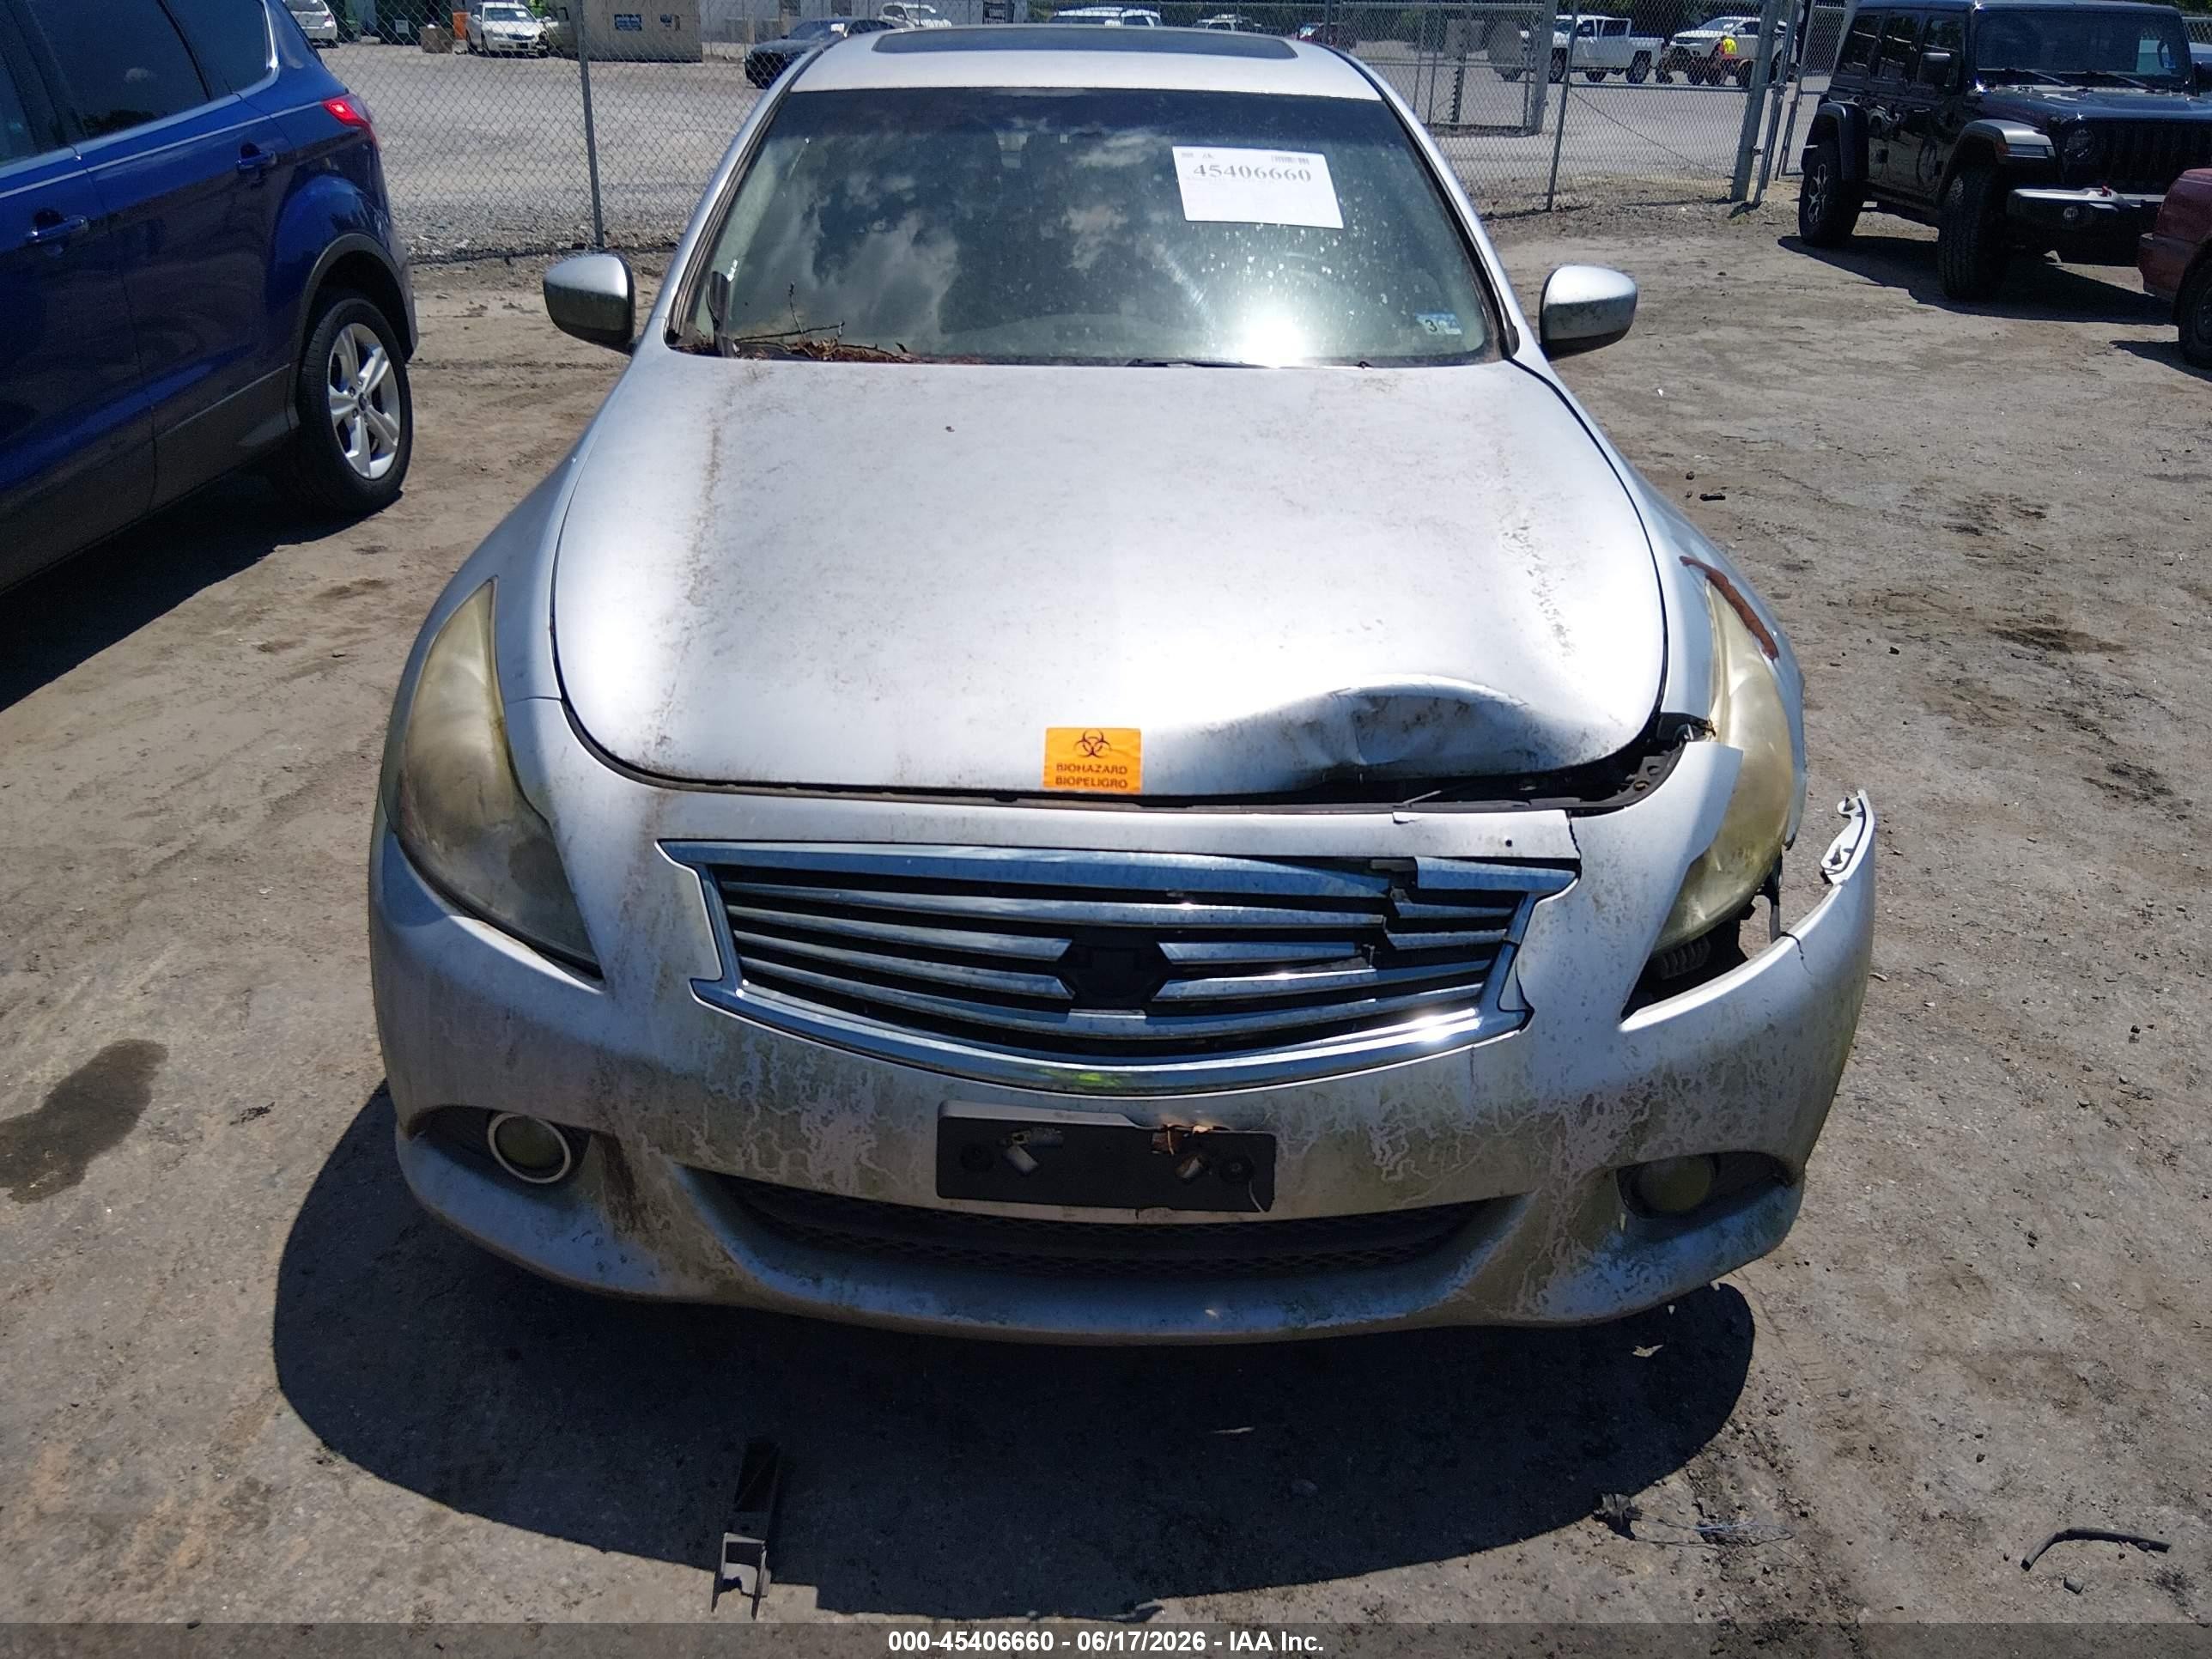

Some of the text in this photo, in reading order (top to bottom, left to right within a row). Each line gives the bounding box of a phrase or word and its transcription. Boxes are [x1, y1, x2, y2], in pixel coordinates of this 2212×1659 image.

[1193, 164, 1311, 183] 45406660
[1055, 763, 1128, 775] BIOHAZARD
[1055, 775, 1128, 788] BIOPELIGRO
